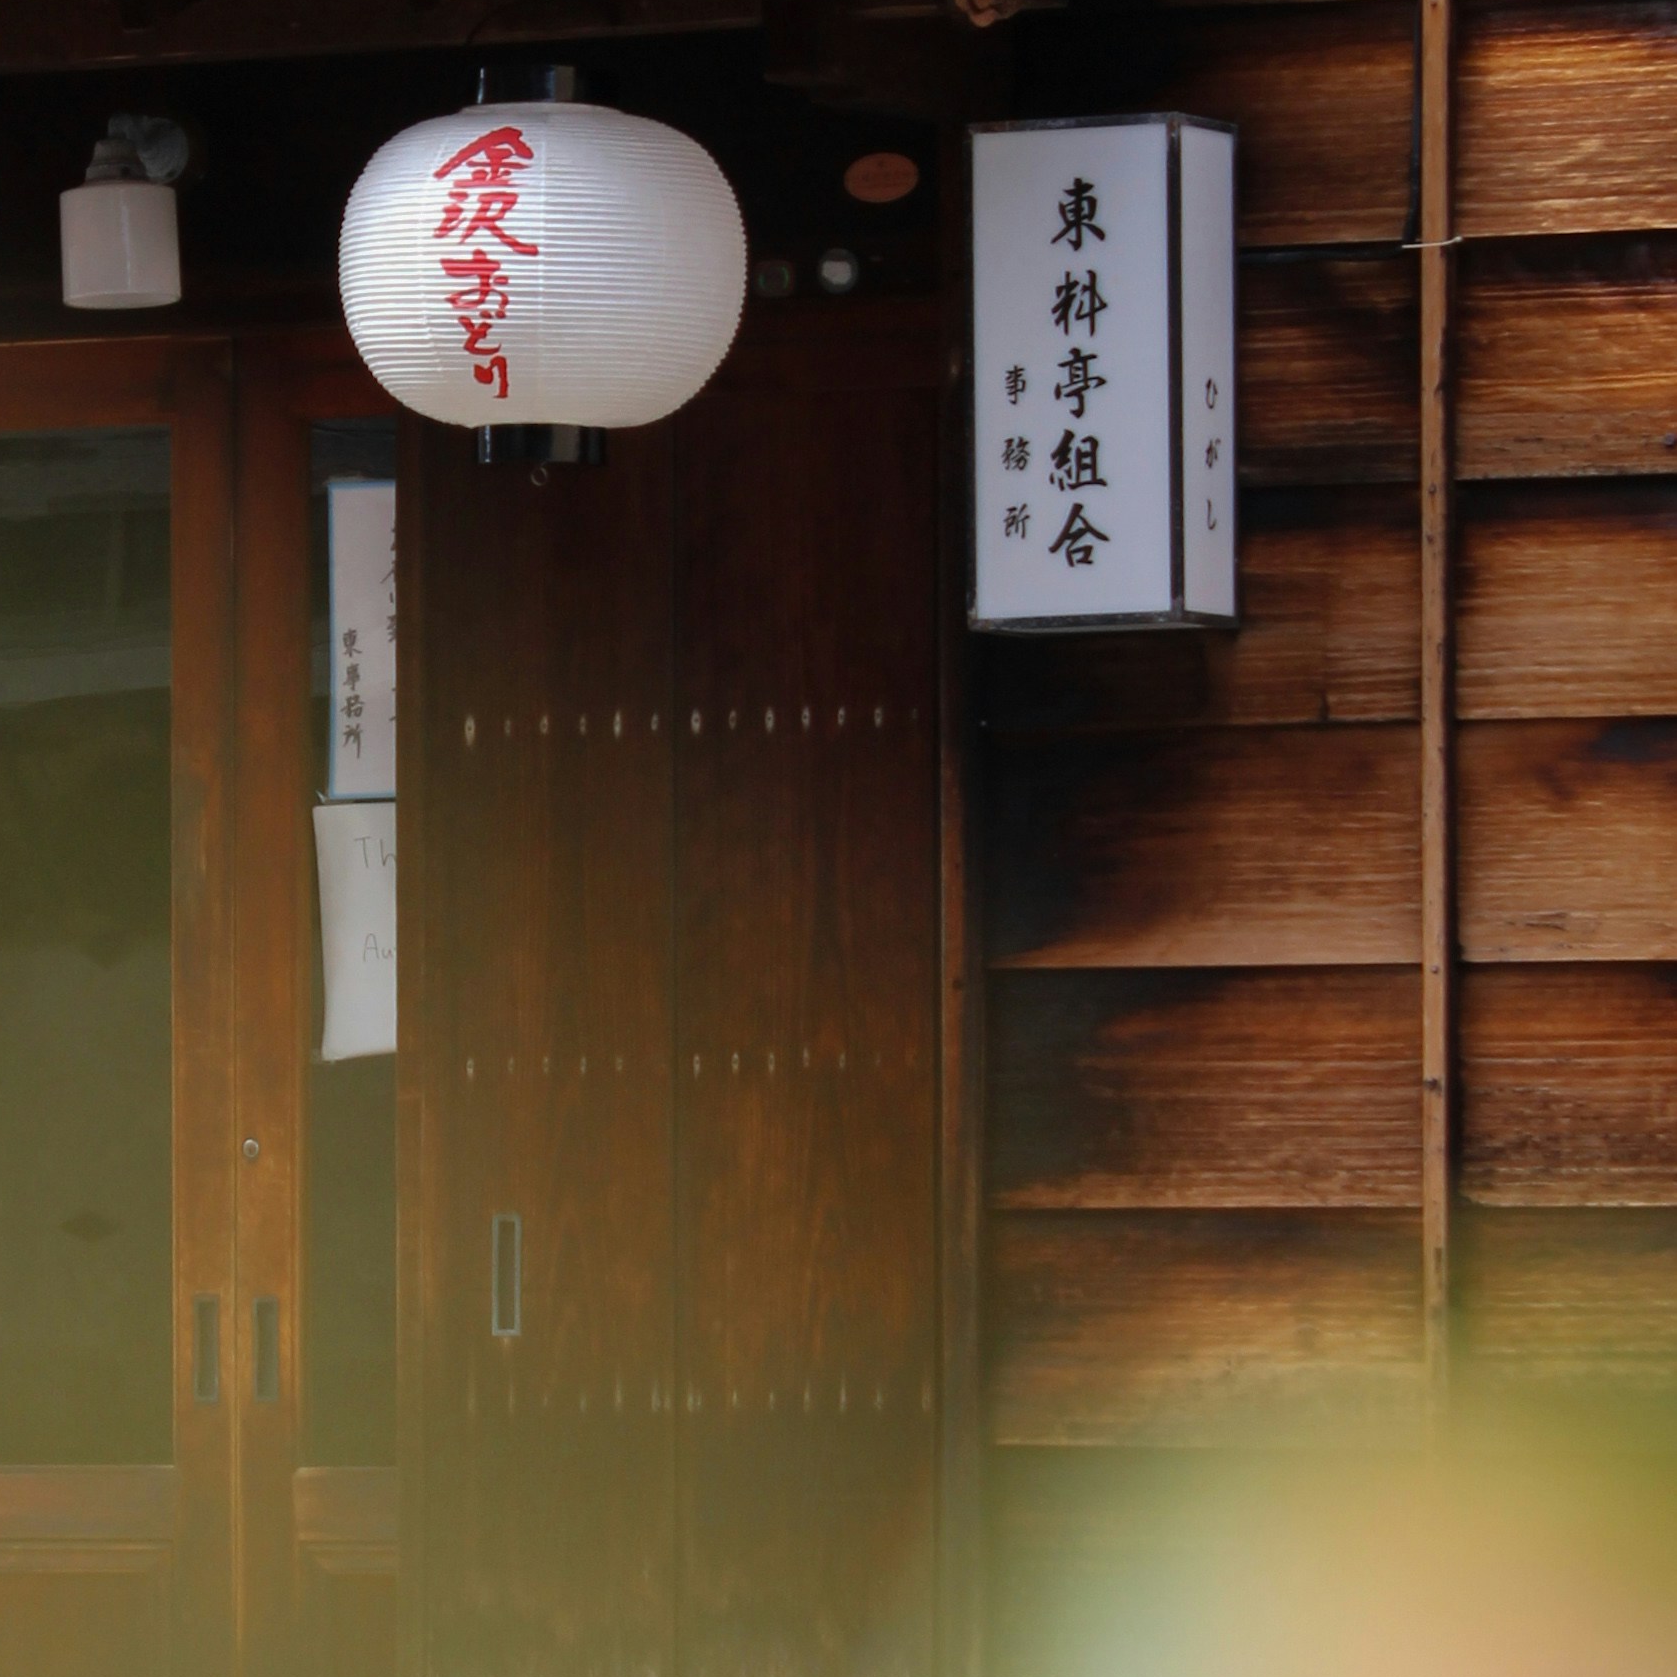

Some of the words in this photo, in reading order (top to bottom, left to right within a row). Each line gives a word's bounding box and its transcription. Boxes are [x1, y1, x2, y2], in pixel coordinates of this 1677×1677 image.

[432, 125, 540, 400] 金沢おどり
[1047, 176, 1111, 569] 東料亭組合
[1001, 363, 1033, 541] 事務所
[1204, 376, 1222, 533] ひがし
